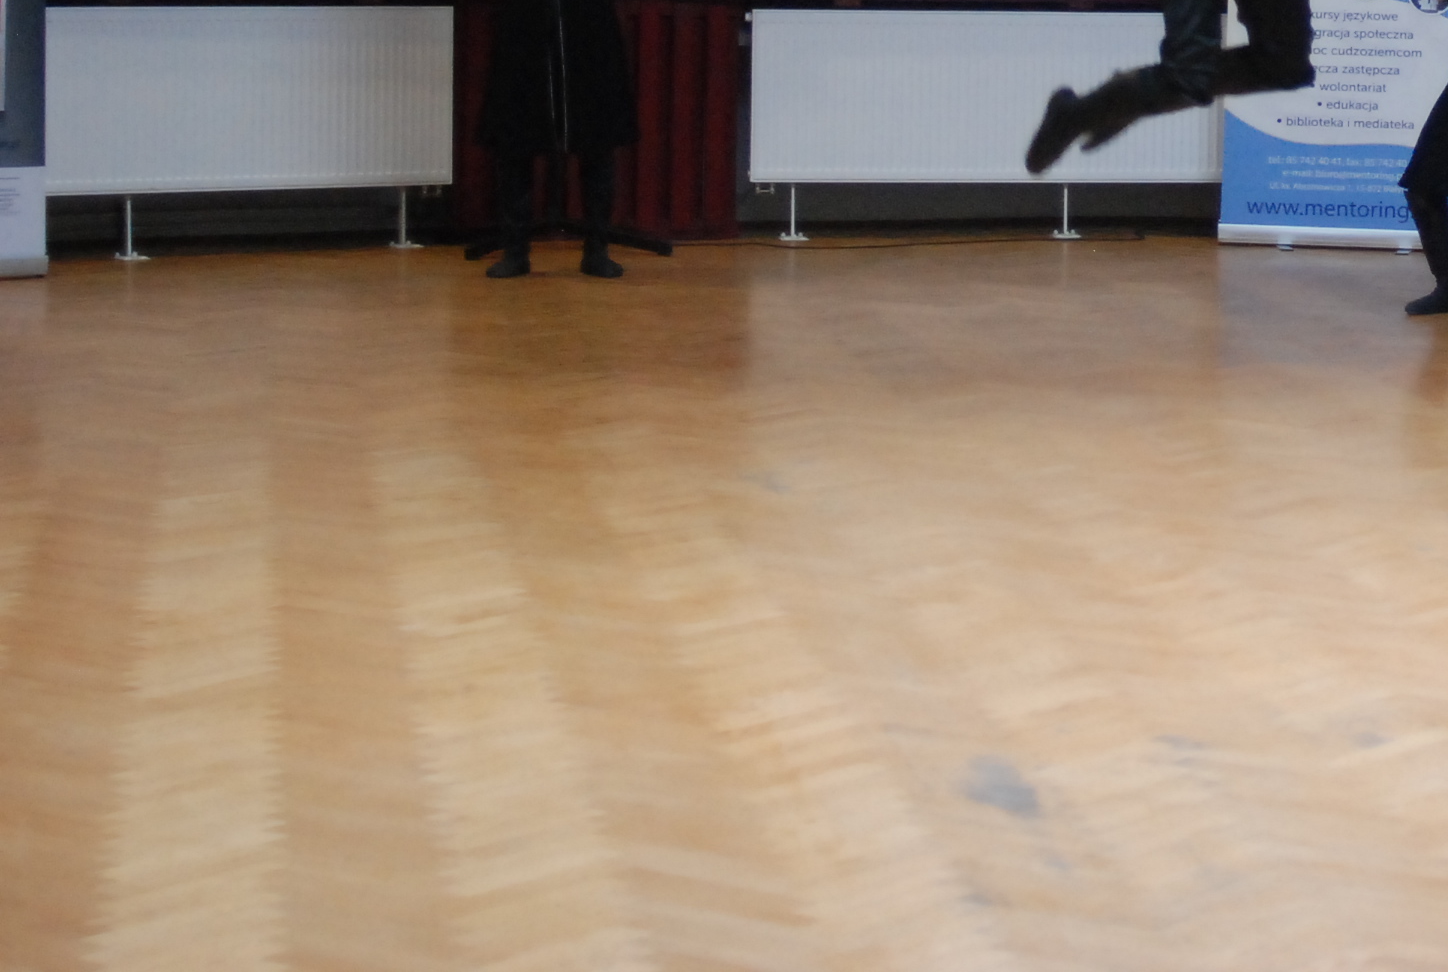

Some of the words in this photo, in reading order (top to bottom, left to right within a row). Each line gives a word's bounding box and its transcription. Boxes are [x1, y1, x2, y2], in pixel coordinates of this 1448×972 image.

[1342, 9, 1398, 23] językowe
[1313, 29, 1350, 40] gracja
[1353, 29, 1414, 40] społeczna
[1331, 46, 1423, 58] cudzoziemcom
[1342, 65, 1400, 76] zastępcza
[1319, 82, 1387, 93] wolontariat
[1326, 100, 1379, 112] edukacja
[1286, 116, 1343, 128] biblioteka
[1353, 118, 1415, 130] mediateka
[1247, 201, 1410, 223] www.mentoring
